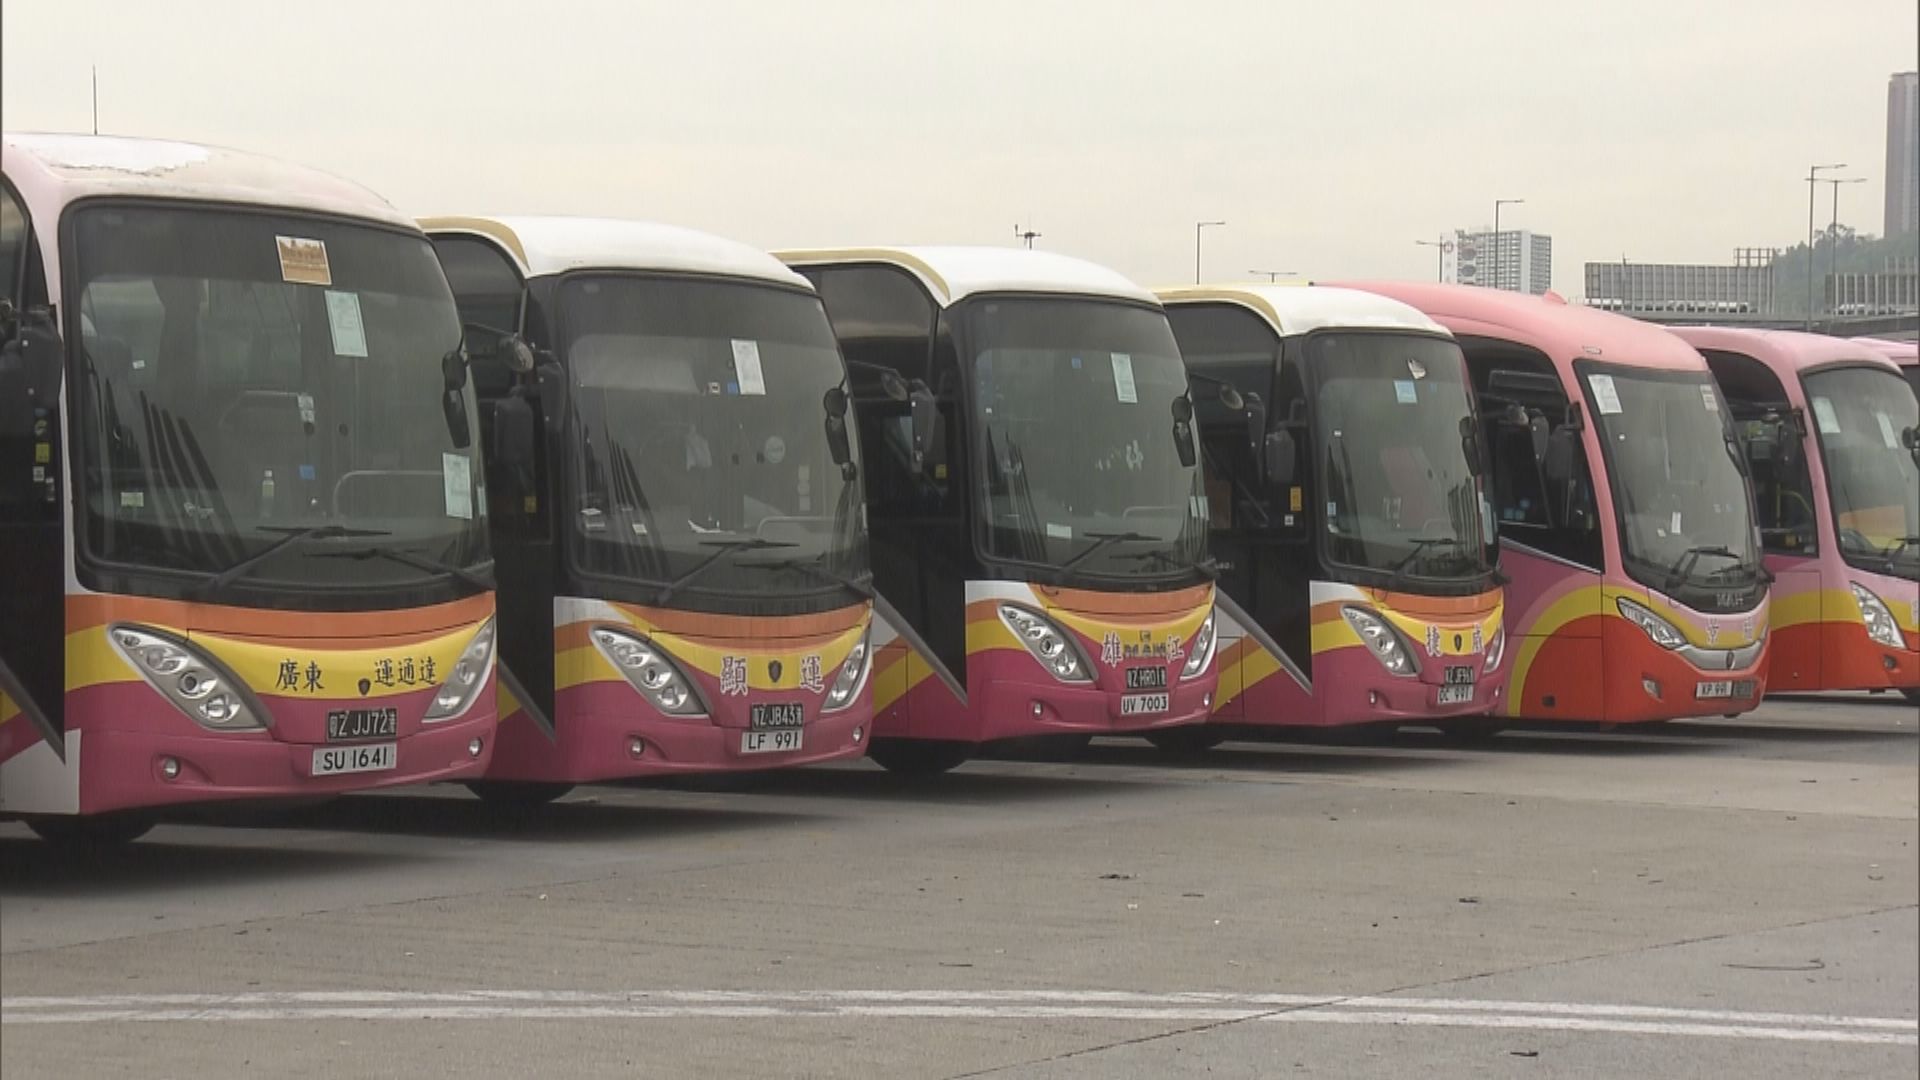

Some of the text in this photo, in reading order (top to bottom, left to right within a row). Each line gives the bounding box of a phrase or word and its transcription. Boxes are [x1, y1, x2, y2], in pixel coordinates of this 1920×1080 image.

[1164, 634, 1184, 662] 江
[276, 656, 437, 692] 廣東 運通達
[800, 654, 825, 693] 運
[1123, 695, 1167, 713] UV 7003
[748, 732, 798, 749] LF 991
[323, 747, 387, 771] SU 1641
